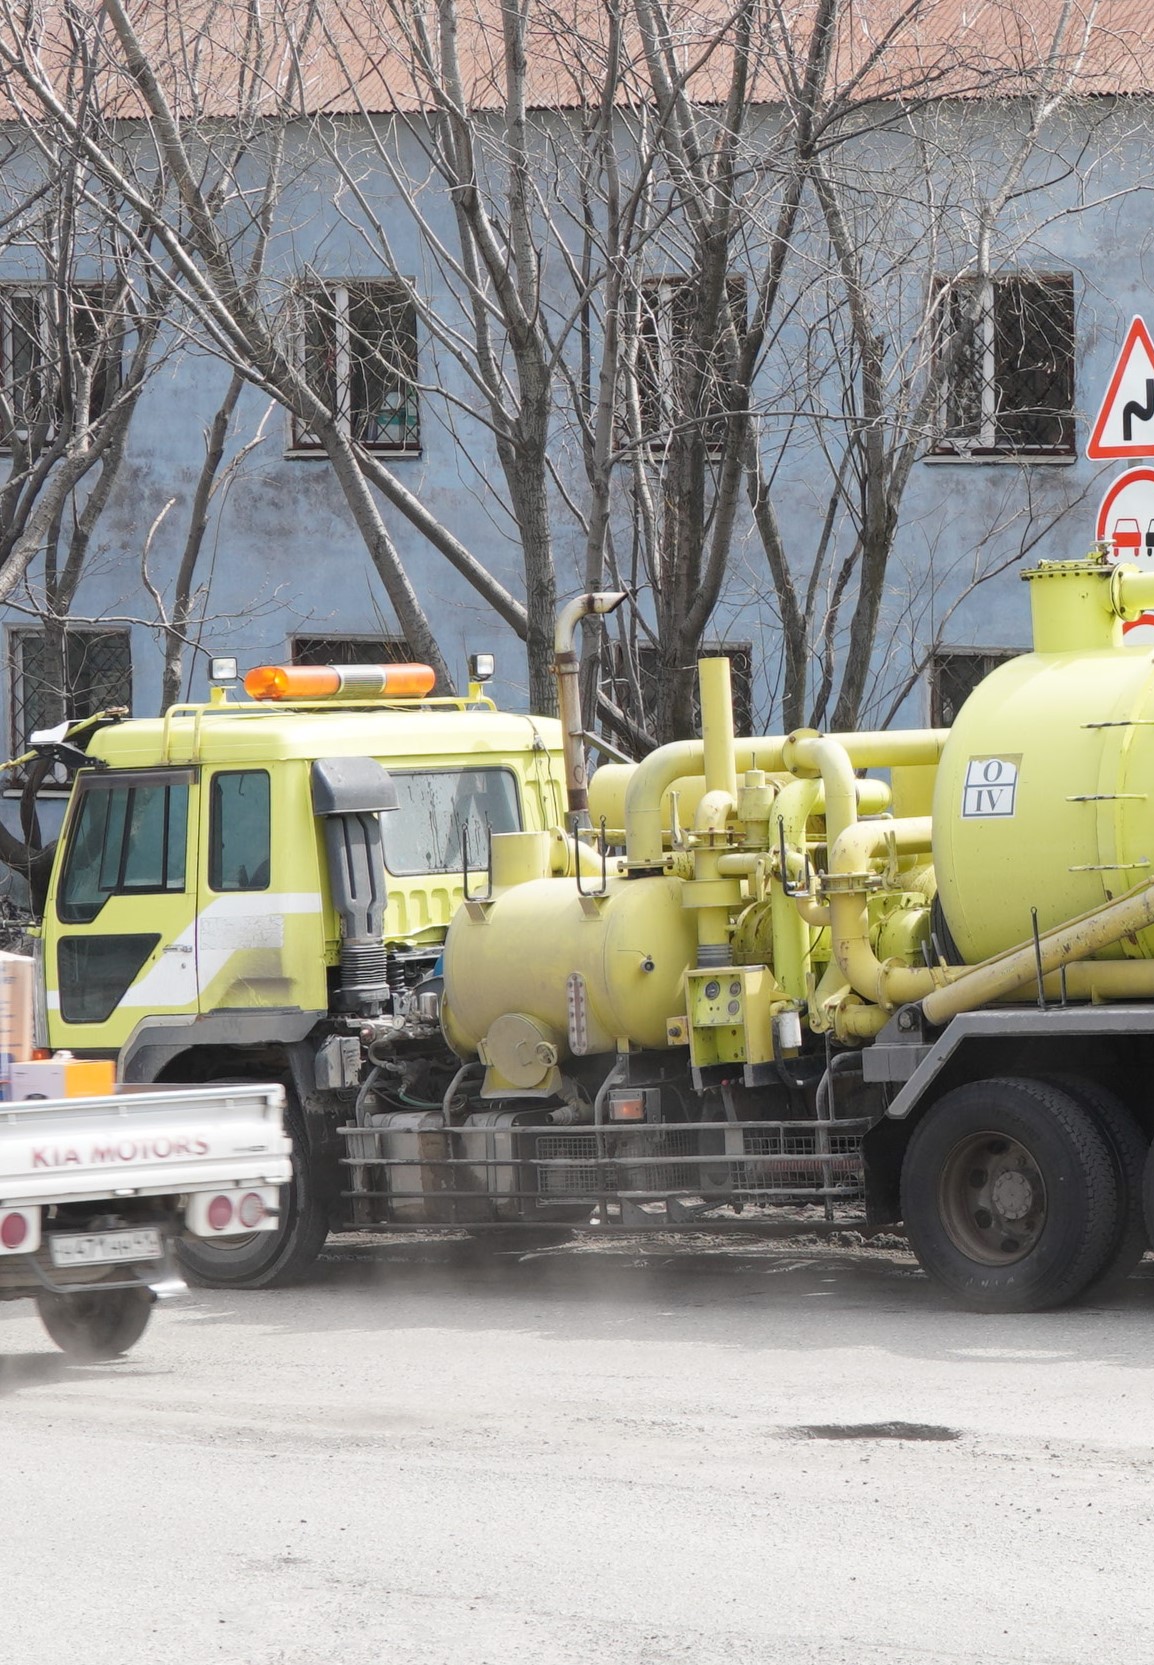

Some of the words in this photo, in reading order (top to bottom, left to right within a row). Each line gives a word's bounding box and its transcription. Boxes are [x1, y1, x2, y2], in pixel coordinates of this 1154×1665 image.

[974, 788, 1004, 813] IV
[31, 1145, 82, 1168] KIA
[90, 1134, 211, 1164] MOTORS
